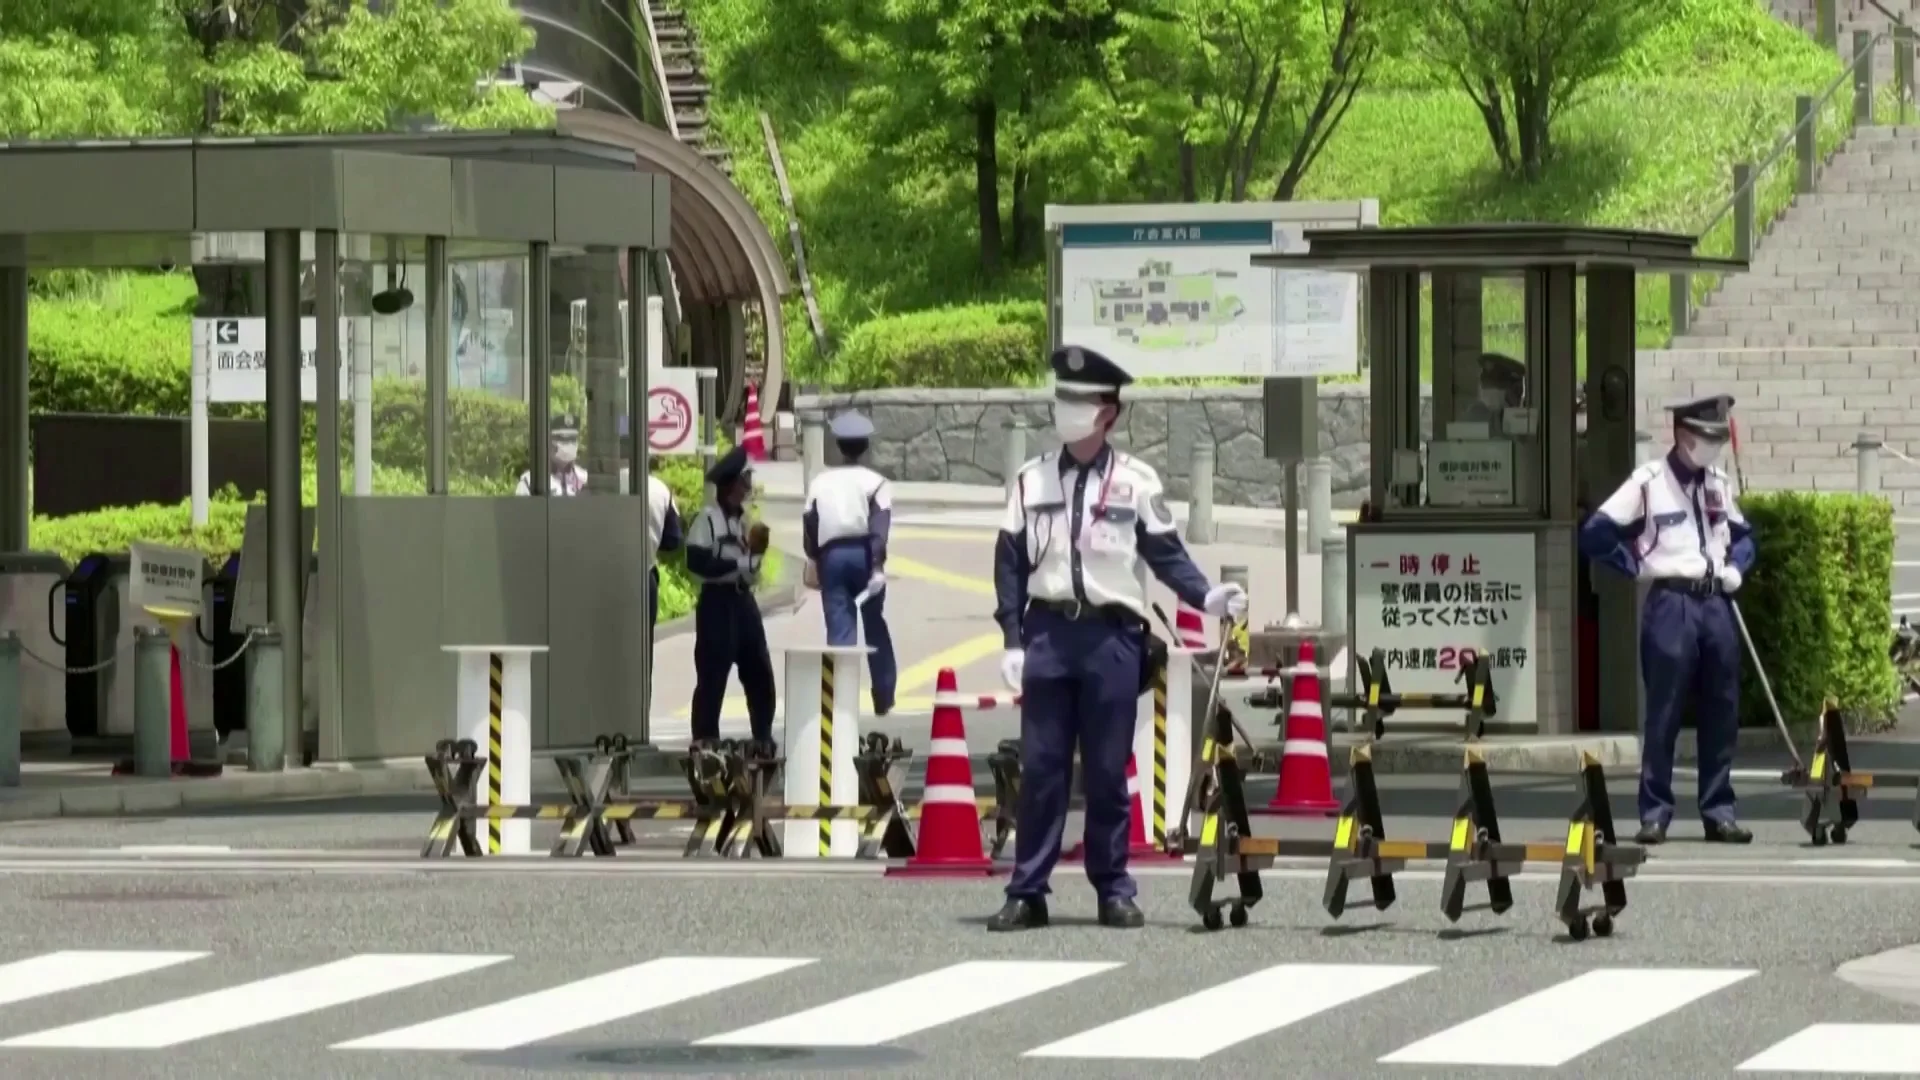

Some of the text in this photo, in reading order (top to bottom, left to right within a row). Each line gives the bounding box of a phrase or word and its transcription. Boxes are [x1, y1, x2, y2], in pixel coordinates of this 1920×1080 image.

[1370, 554, 1481, 576] 一時停止
[1381, 582, 1522, 604] 警備員の指示に
[1382, 607, 1508, 628] 従ってください
